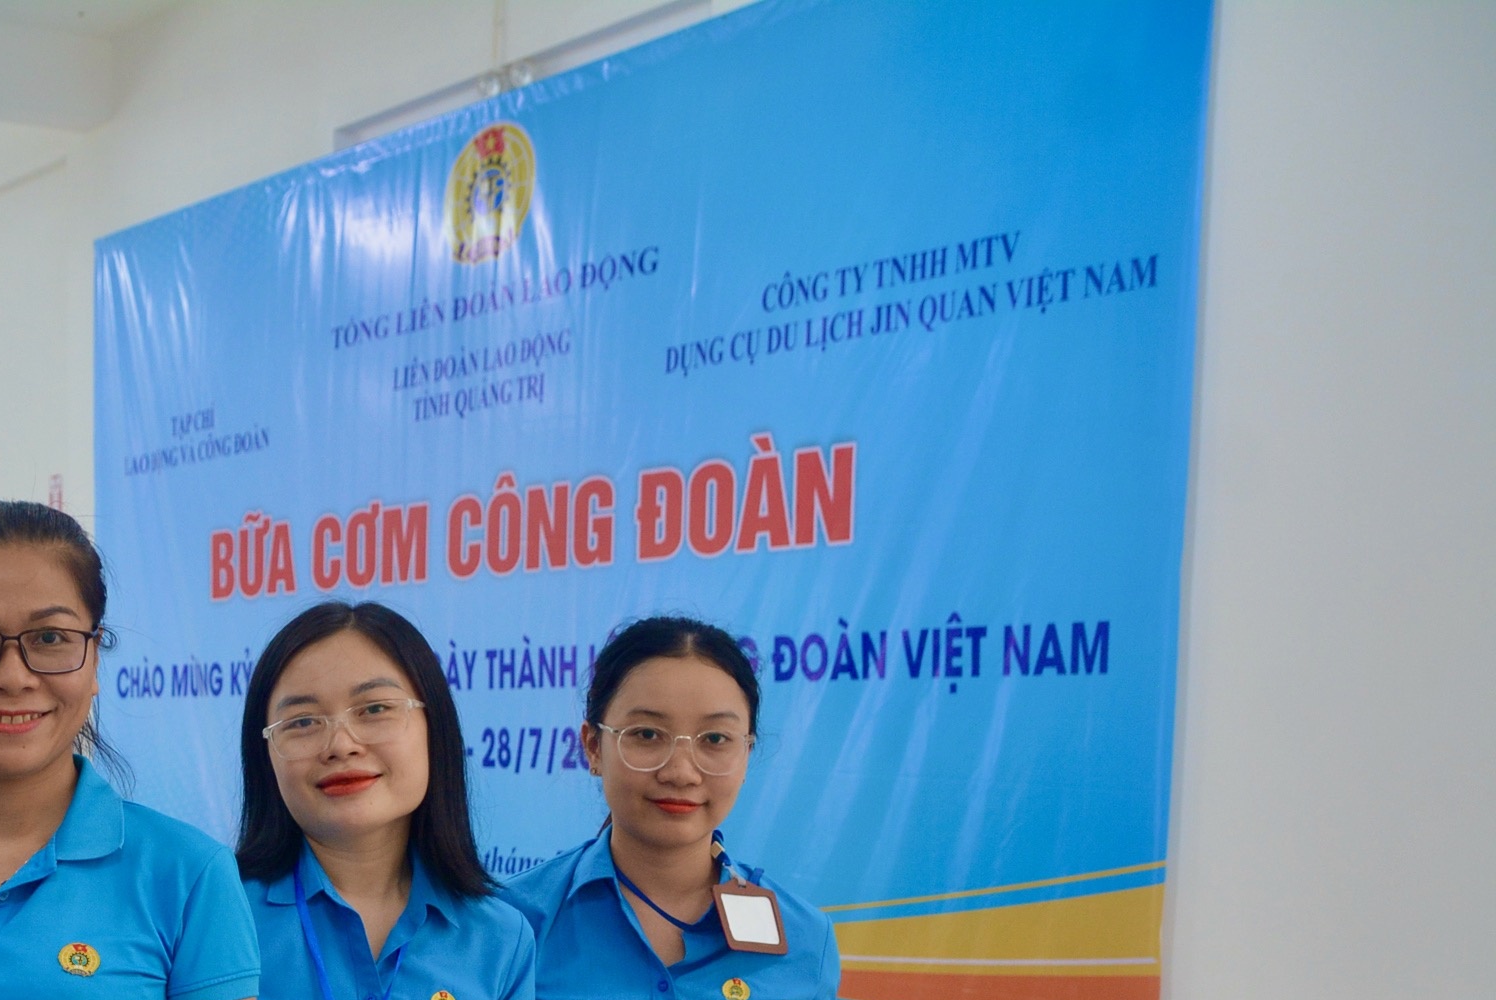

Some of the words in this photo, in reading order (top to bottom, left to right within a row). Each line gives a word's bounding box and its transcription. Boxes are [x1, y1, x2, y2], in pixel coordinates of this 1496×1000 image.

[522, 267, 572, 304] LAO
[580, 246, 659, 291] ĐỘNG
[762, 271, 830, 313] CÔNG
[836, 265, 868, 297] TY
[874, 246, 949, 290] TNHH
[955, 230, 1021, 272] MTV
[483, 341, 517, 371] LAO
[520, 328, 571, 367] ĐỘNG
[665, 335, 724, 377] DỤNG
[730, 329, 761, 365] CỤ
[766, 321, 799, 355] DU
[806, 309, 864, 352] LỊCH
[870, 300, 911, 337] JIN
[919, 284, 998, 332] QUAN
[1007, 267, 1075, 313] VIỆT
[1083, 253, 1160, 299] NAM
[517, 372, 546, 404] TRỊ
[210, 511, 296, 600] BỮA
[311, 499, 429, 593] CƠM
[448, 473, 615, 579] CÔNG
[636, 434, 857, 562] ĐOÀN
[117, 656, 164, 698] CHÀO
[485, 635, 577, 690] THÀNH
[772, 617, 887, 682] ĐOÀN
[902, 611, 987, 694] VIỆT
[1003, 621, 1110, 677] NAM
